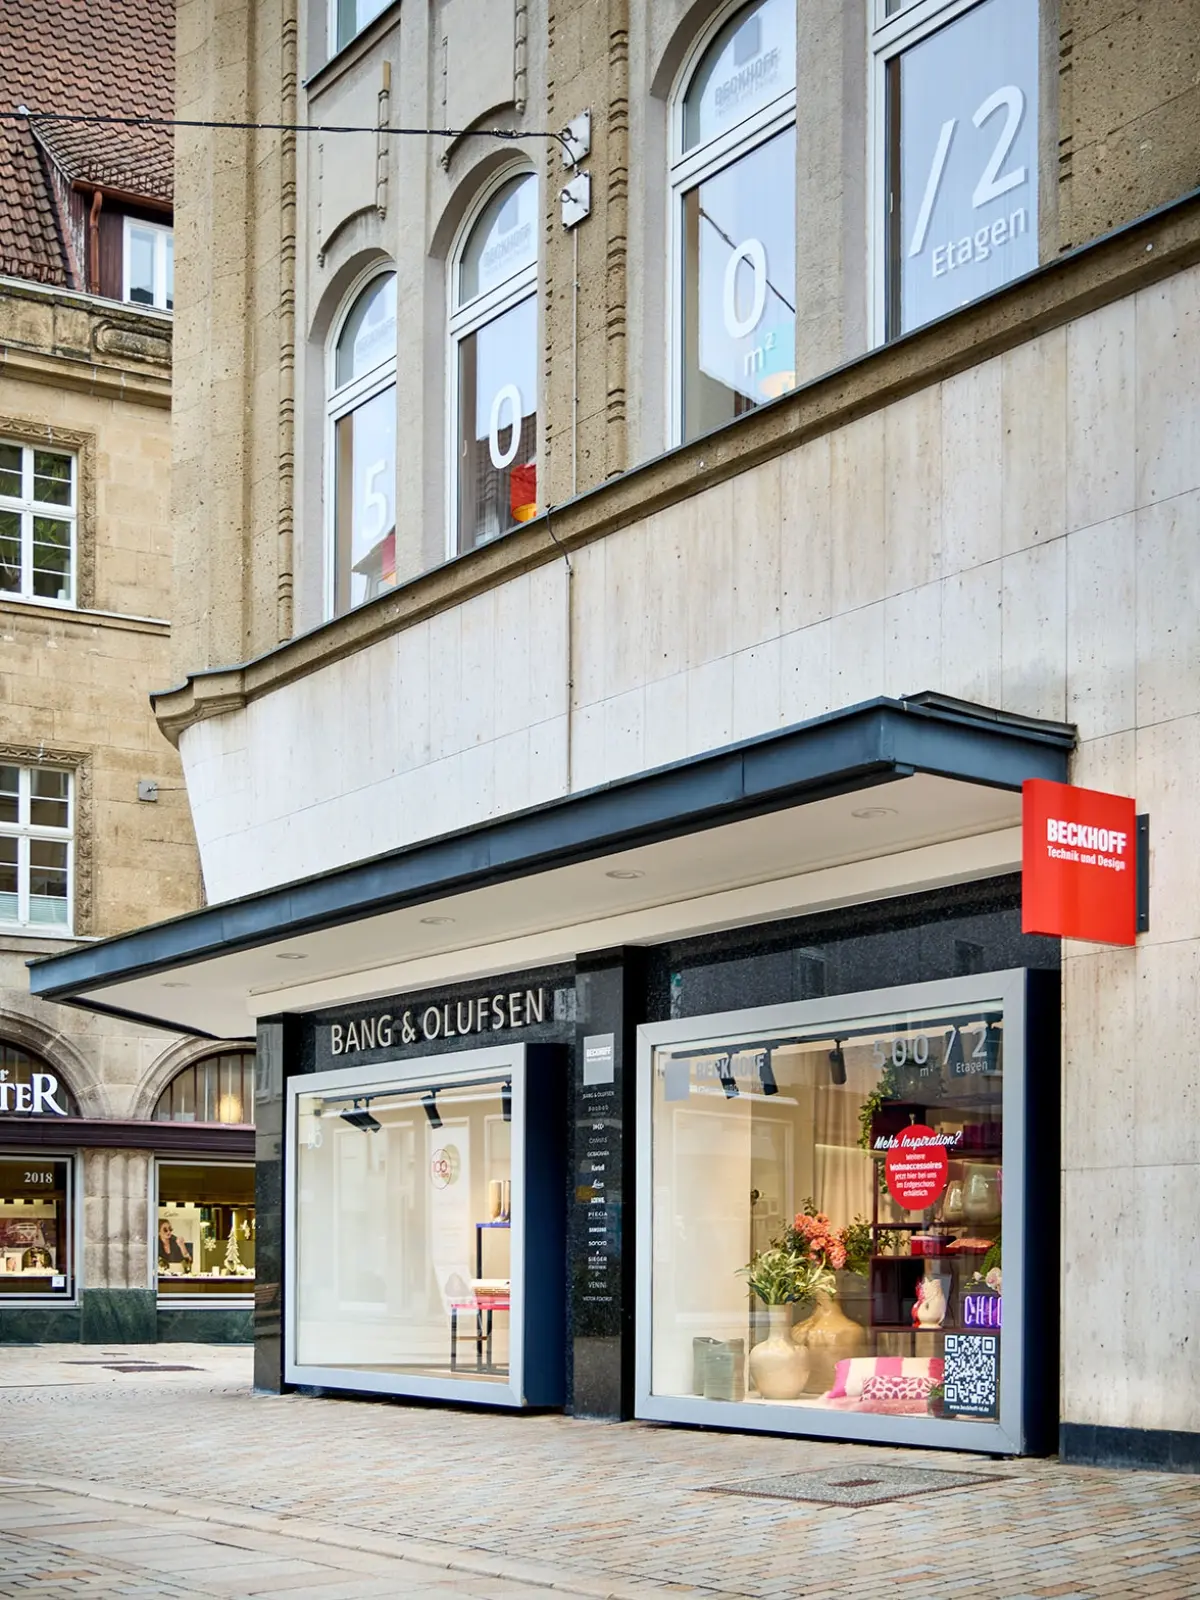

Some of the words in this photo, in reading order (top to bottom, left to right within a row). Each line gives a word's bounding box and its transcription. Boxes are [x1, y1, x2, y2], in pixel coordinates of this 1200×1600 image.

[932, 207, 1028, 278] Etagen
[362, 459, 387, 541] 5
[489, 383, 522, 469] 0
[724, 238, 767, 339] 0
[1047, 818, 1127, 854] BECKHOFF
[1047, 845, 1079, 861] Technik
[1081, 853, 1096, 865] und
[1098, 854, 1125, 871] Design
[331, 1015, 393, 1055] BANG
[401, 1011, 415, 1043] &
[423, 987, 544, 1040] OLUFSEN
[956, 1061, 988, 1074] Etagen
[874, 1134, 899, 1149] Mehr
[901, 1130, 962, 1150] Inspiration?
[24, 1172, 53, 1184] 2018
